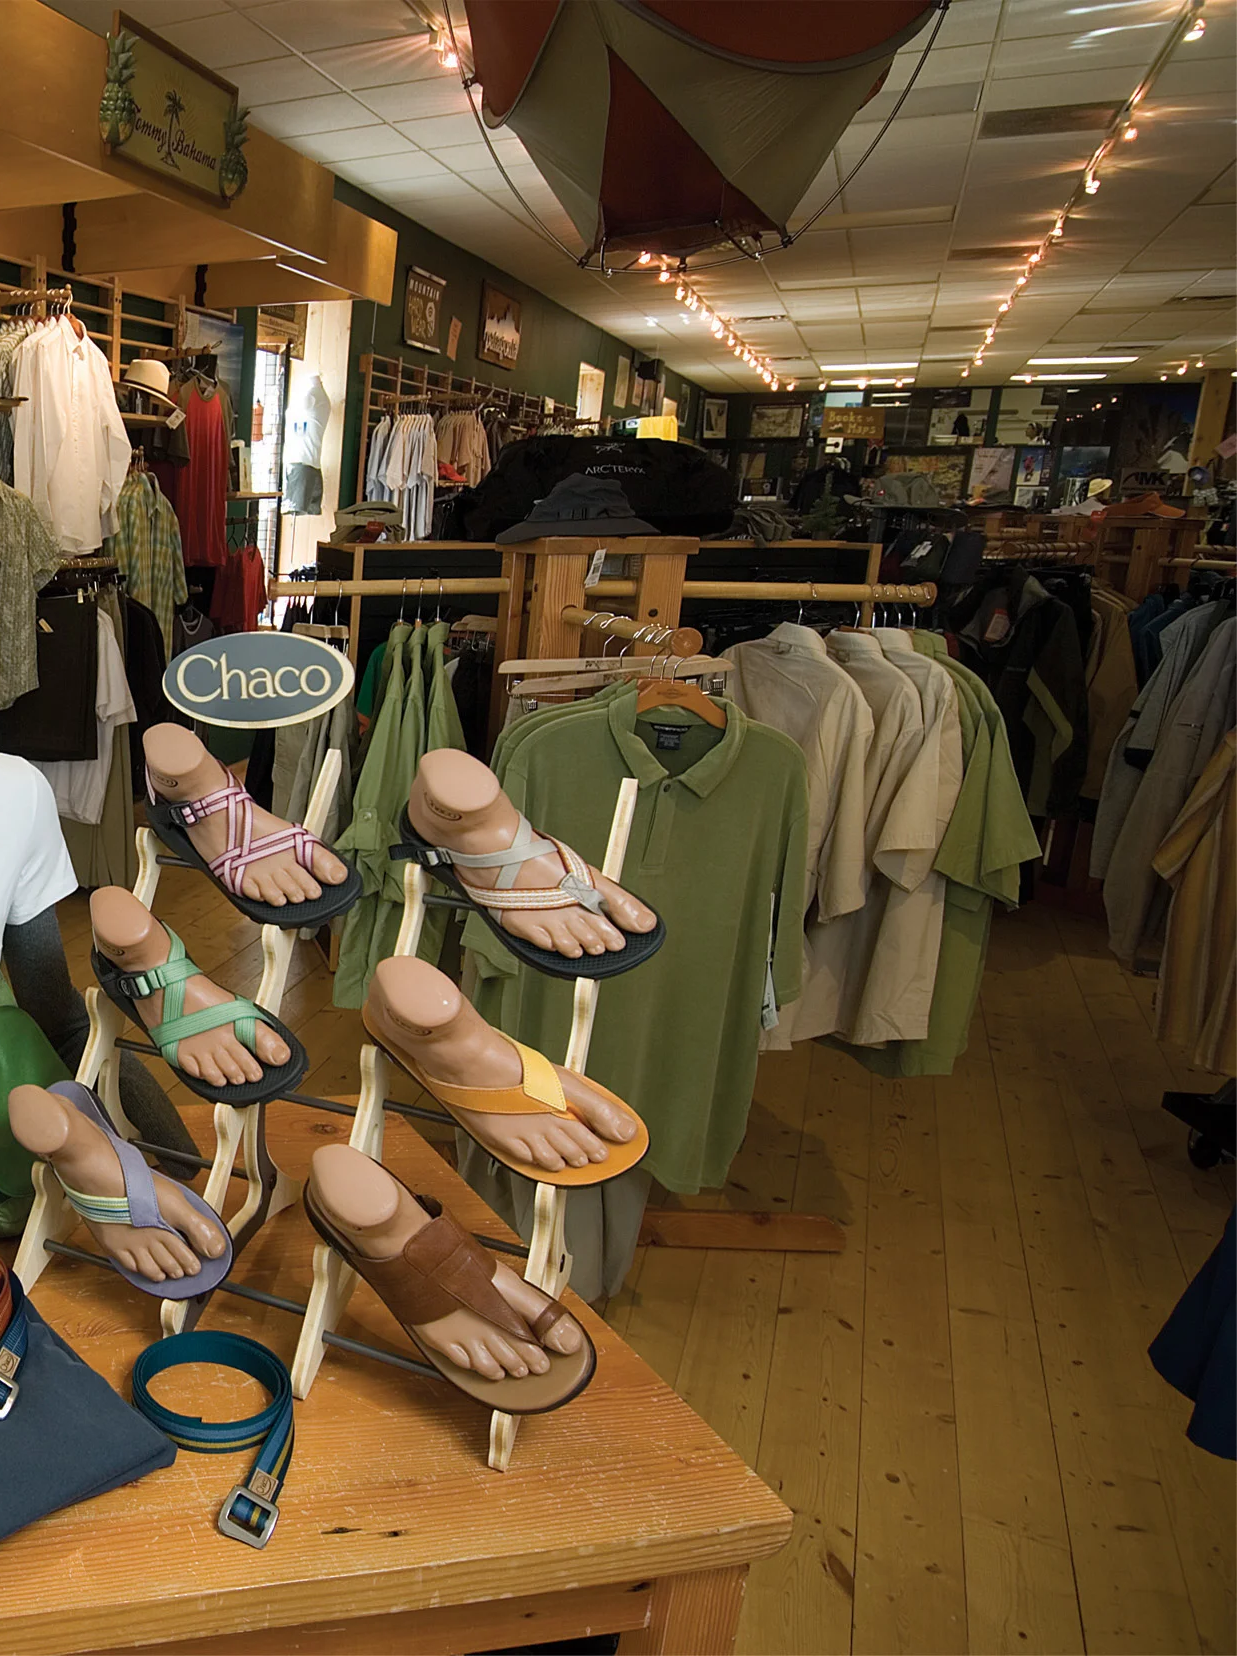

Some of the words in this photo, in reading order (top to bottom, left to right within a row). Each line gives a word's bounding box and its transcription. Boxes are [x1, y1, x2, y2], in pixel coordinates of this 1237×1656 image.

[134, 102, 167, 153] Tommy
[172, 130, 217, 171] Bahama
[409, 279, 440, 301] MOUNTAIN
[484, 331, 517, 360] patagonia
[828, 410, 863, 423] Books
[846, 422, 876, 435] Maps
[176, 652, 332, 703] Chaco
